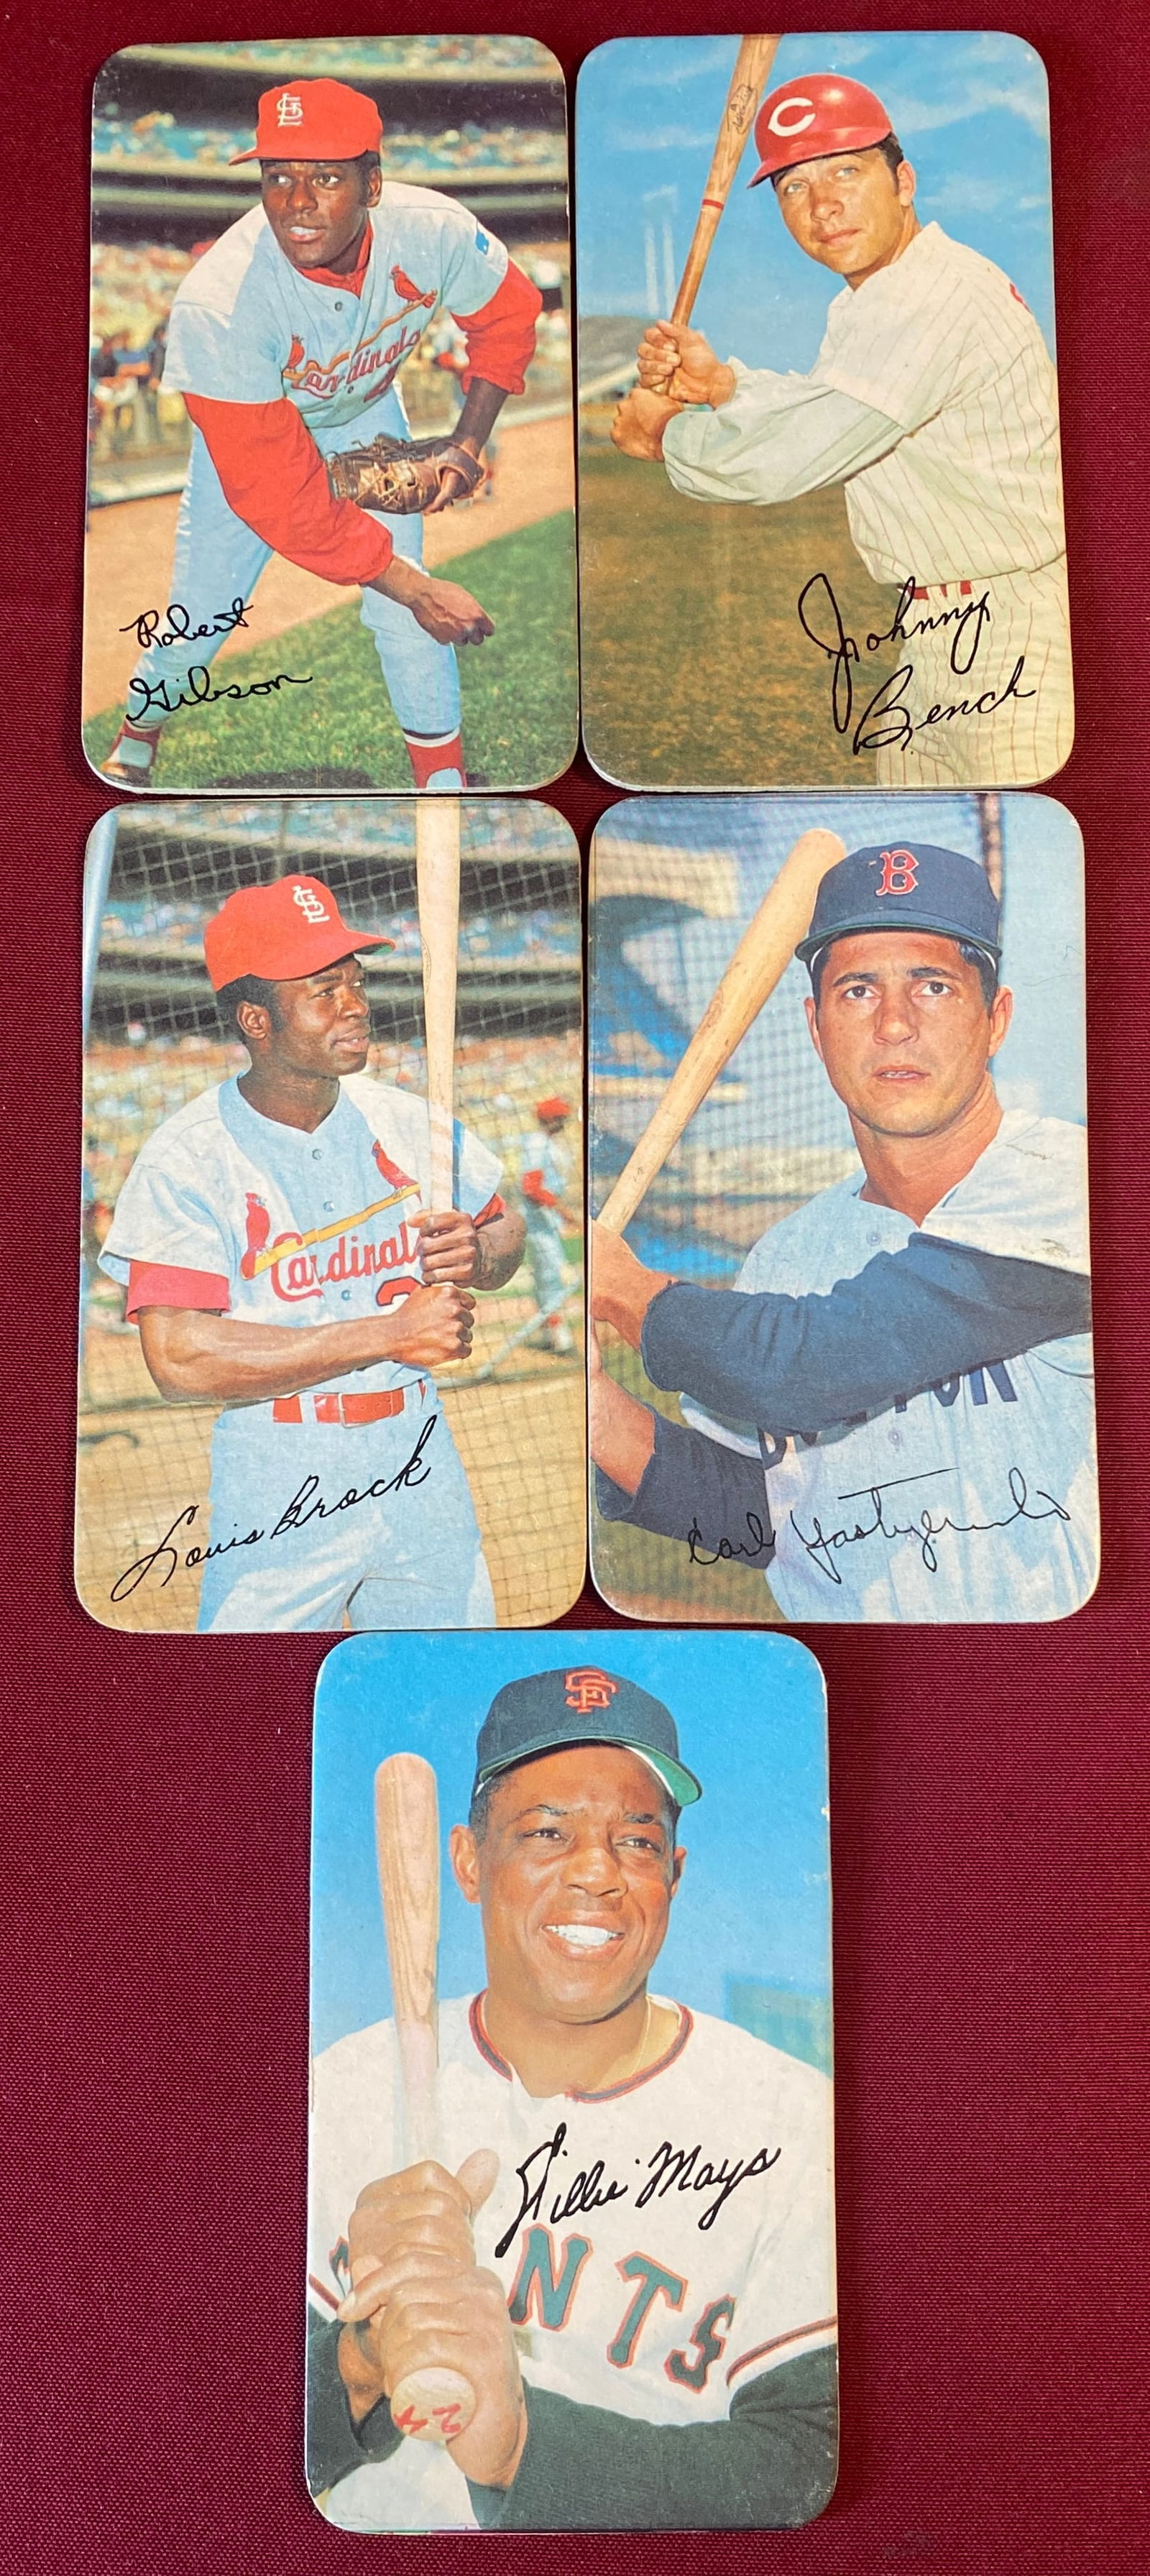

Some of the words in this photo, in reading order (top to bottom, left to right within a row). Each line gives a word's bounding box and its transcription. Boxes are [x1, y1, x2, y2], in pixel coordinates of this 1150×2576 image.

[767, 96, 816, 137] C
[291, 326, 421, 400] Cardinals
[119, 597, 254, 648] Robert
[798, 573, 991, 734] Johnny
[125, 666, 313, 721] Gibson
[853, 656, 1036, 755] Bench
[875, 850, 919, 896] B
[270, 1220, 421, 1303] Cardinal
[110, 1505, 265, 1603] Louis
[270, 1414, 438, 1540] Brock
[689, 1512, 776, 1565] Carl
[634, 2140, 783, 2231] Mays
[393, 2403, 462, 2434] 24
